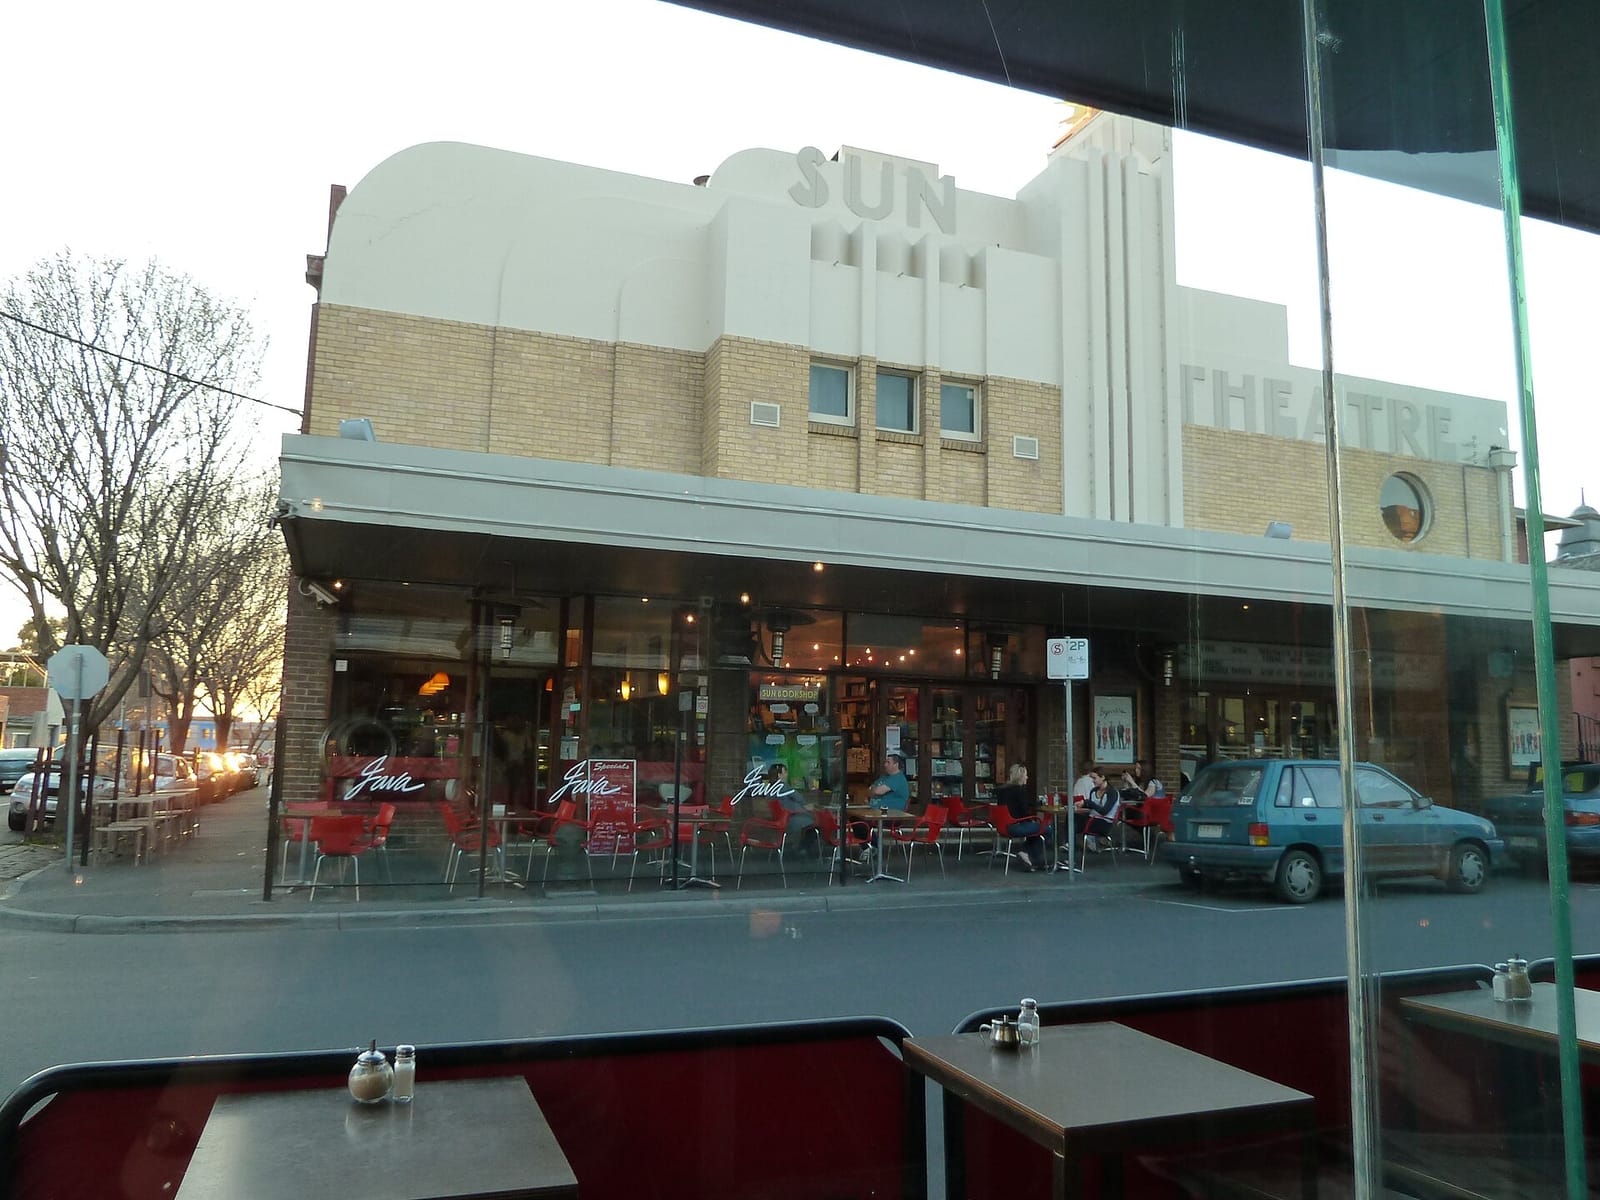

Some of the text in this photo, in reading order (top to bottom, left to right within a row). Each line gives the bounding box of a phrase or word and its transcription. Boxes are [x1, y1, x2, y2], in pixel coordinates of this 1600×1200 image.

[788, 146, 956, 234] SUN
[1181, 364, 1457, 463] THEATRE
[1069, 641, 1086, 651] 2P
[344, 754, 426, 801] Java
[549, 758, 621, 804] Java
[593, 761, 631, 773] Specials
[731, 765, 795, 805] Java
